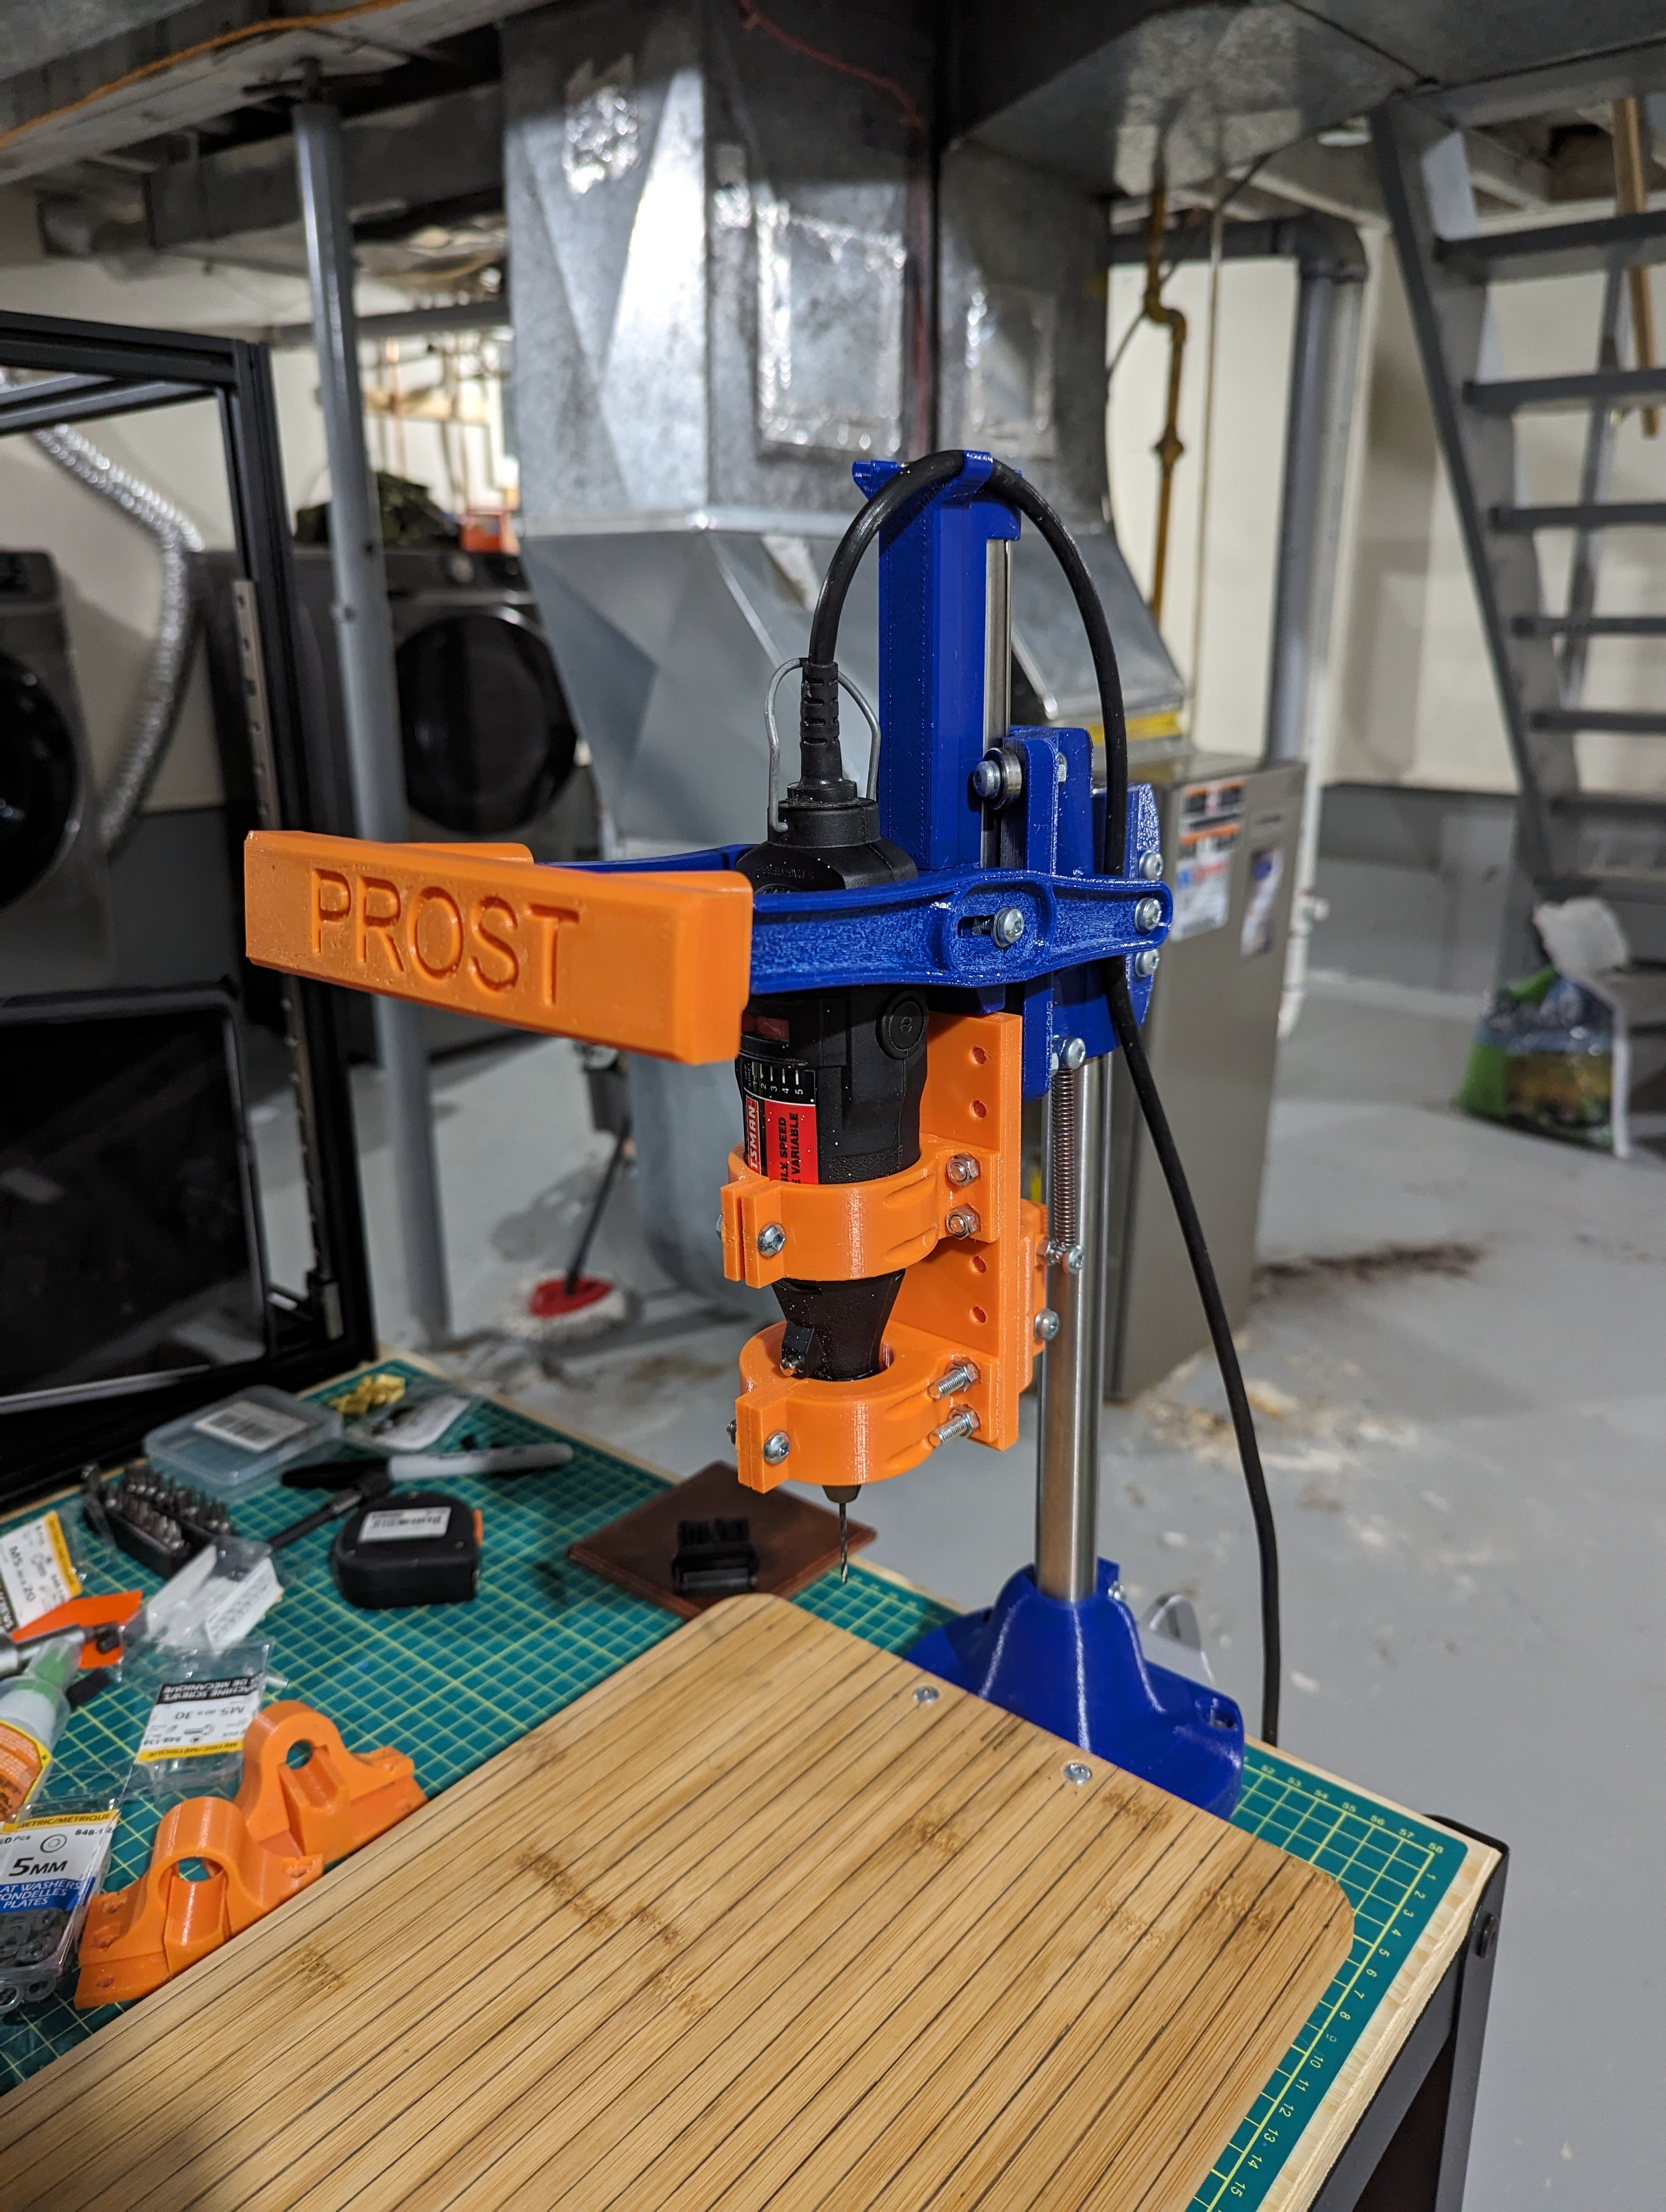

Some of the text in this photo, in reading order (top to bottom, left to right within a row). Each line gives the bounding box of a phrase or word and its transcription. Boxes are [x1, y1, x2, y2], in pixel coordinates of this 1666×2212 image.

[312, 868, 581, 1006] PROST
[778, 1117, 788, 1159] SPEED
[789, 1113, 801, 1175] VARIABLE
[1314, 1789, 1328, 1799] 54
[1342, 1802, 1357, 1812] 55
[1370, 1815, 1385, 1825] 56
[1399, 1828, 1415, 1838] 57
[1428, 1842, 1444, 1854] 58
[9, 1857, 68, 1876] 5MM
[21, 1880, 82, 1892] WASHERS
[1414, 1890, 1426, 1899] 2
[3, 1897, 49, 1909] PLATES
[1402, 1909, 1414, 1918] 3
[1391, 1928, 1402, 1937] 4
[1379, 1949, 1390, 1957] 5
[1366, 1969, 1377, 1978] 6
[1354, 1990, 1365, 1999] 7
[1339, 2011, 1351, 2021] 8
[1326, 2034, 1337, 2042] 9
[1310, 2055, 1324, 2068] 10
[1295, 2079, 1310, 2092] 11
[1279, 2103, 1295, 2118] 12
[1264, 2128, 1279, 2143] 13
[1247, 2154, 1263, 2169] 14
[1230, 2181, 1246, 2197] 15
